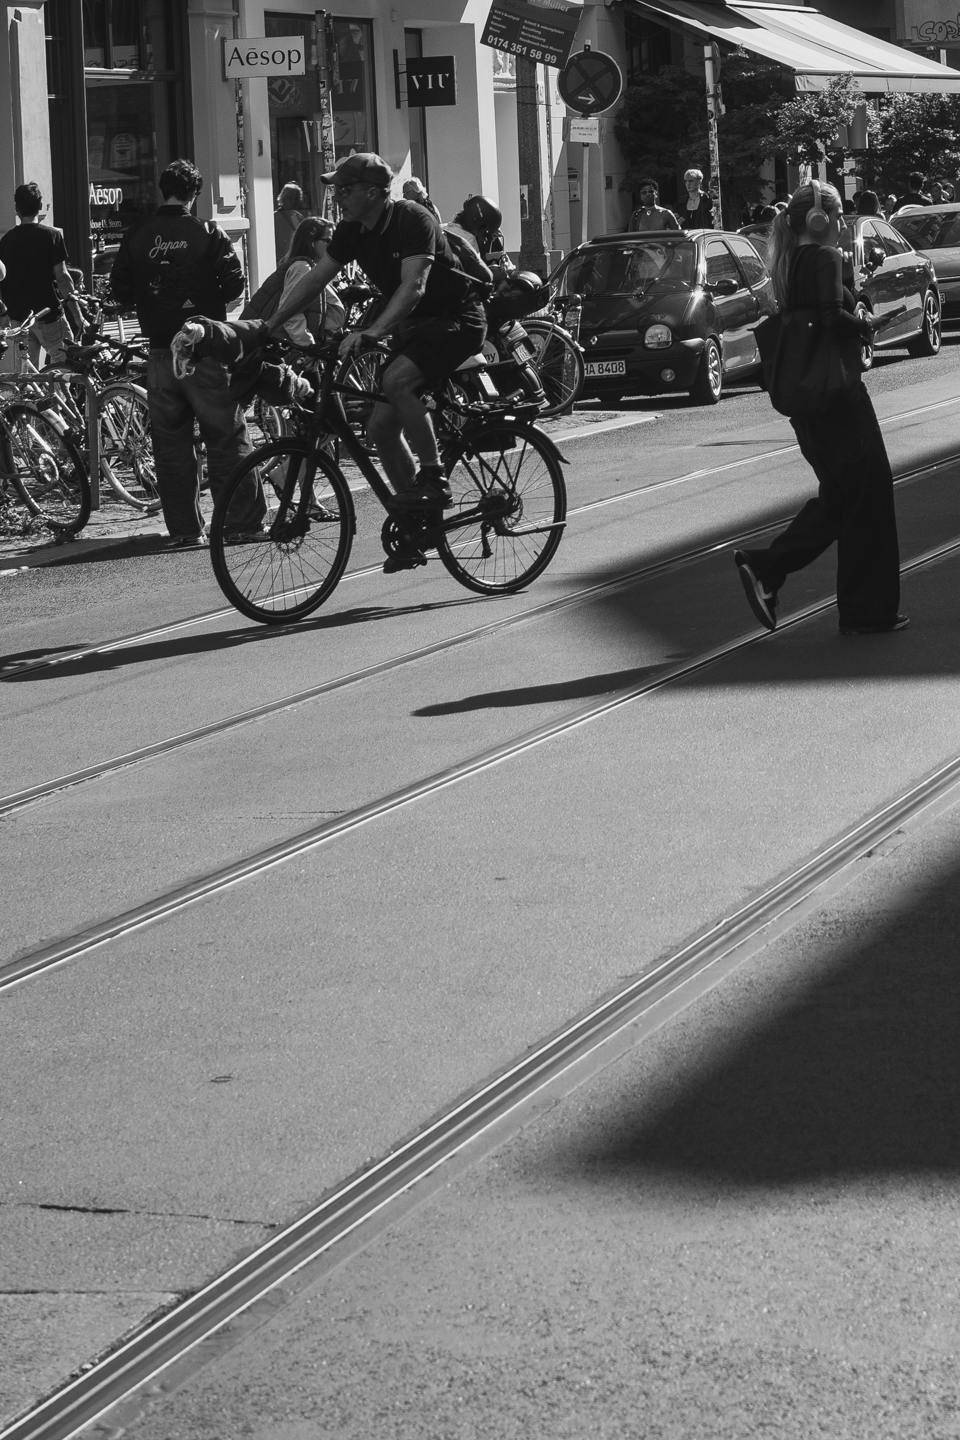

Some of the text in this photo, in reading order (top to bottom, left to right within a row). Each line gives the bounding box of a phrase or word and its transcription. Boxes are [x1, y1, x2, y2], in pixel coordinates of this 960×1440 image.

[487, 34, 509, 49] 0174
[510, 42, 527, 55] 351
[529, 48, 543, 60] 58
[544, 53, 557, 64] 99
[149, 234, 188, 258] Japan
[597, 361, 625, 375] 8408
